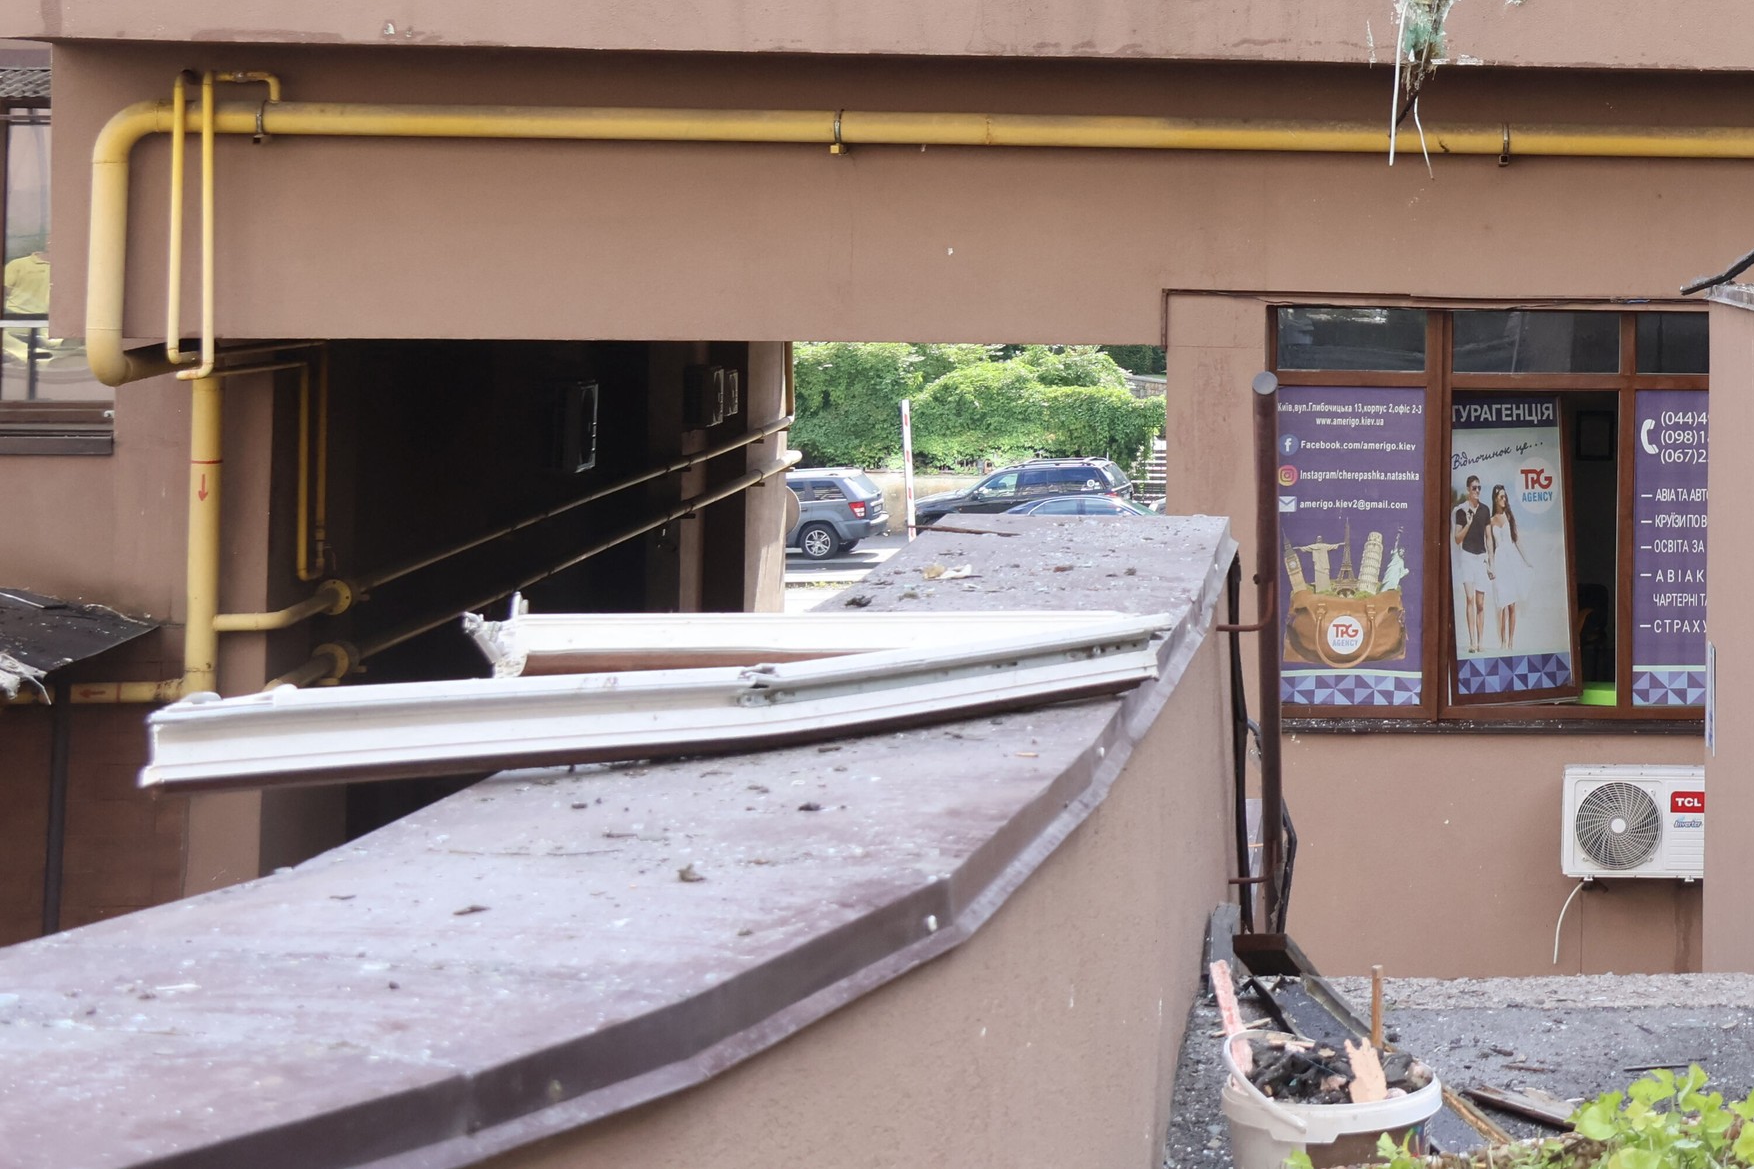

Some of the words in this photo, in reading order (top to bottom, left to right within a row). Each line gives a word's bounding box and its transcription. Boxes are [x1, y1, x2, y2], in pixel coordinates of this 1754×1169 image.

[1411, 404, 1422, 414] 2-3
[1452, 402, 1554, 425] ТУРАГЕНЦІЯ
[1315, 417, 1384, 428] www.amerigo.kiev.ua
[1660, 411, 1709, 427] (044)4
[1660, 430, 1709, 446] (098)1
[1300, 440, 1416, 452] Facebook.com/amerigo.kiev
[1450, 446, 1512, 471] Відпочинок
[1660, 448, 1709, 465] (067)2
[1300, 470, 1420, 482] Instagram/cherepashka.natashka
[1520, 468, 1553, 490] TPG
[1521, 491, 1553, 503] AGENCY
[1655, 488, 1676, 502] АВІА
[1677, 488, 1689, 502] ТА
[1689, 488, 1709, 502] АВТ
[1299, 499, 1408, 510] amerigo.kiev2@gmail.com
[1655, 512, 1686, 528] КРУЇЗИ
[1687, 514, 1700, 528] ПО
[1653, 539, 1689, 553] ОСВІТА
[1691, 539, 1705, 553] ЗА
[1655, 569, 1705, 583] АВІАК
[1652, 593, 1698, 607] ЧАРТЕРНІ
[1332, 624, 1359, 638] TPG
[1332, 639, 1359, 647] AGENCY
[1675, 797, 1702, 807] TCL
[1673, 819, 1703, 829] Inverter
